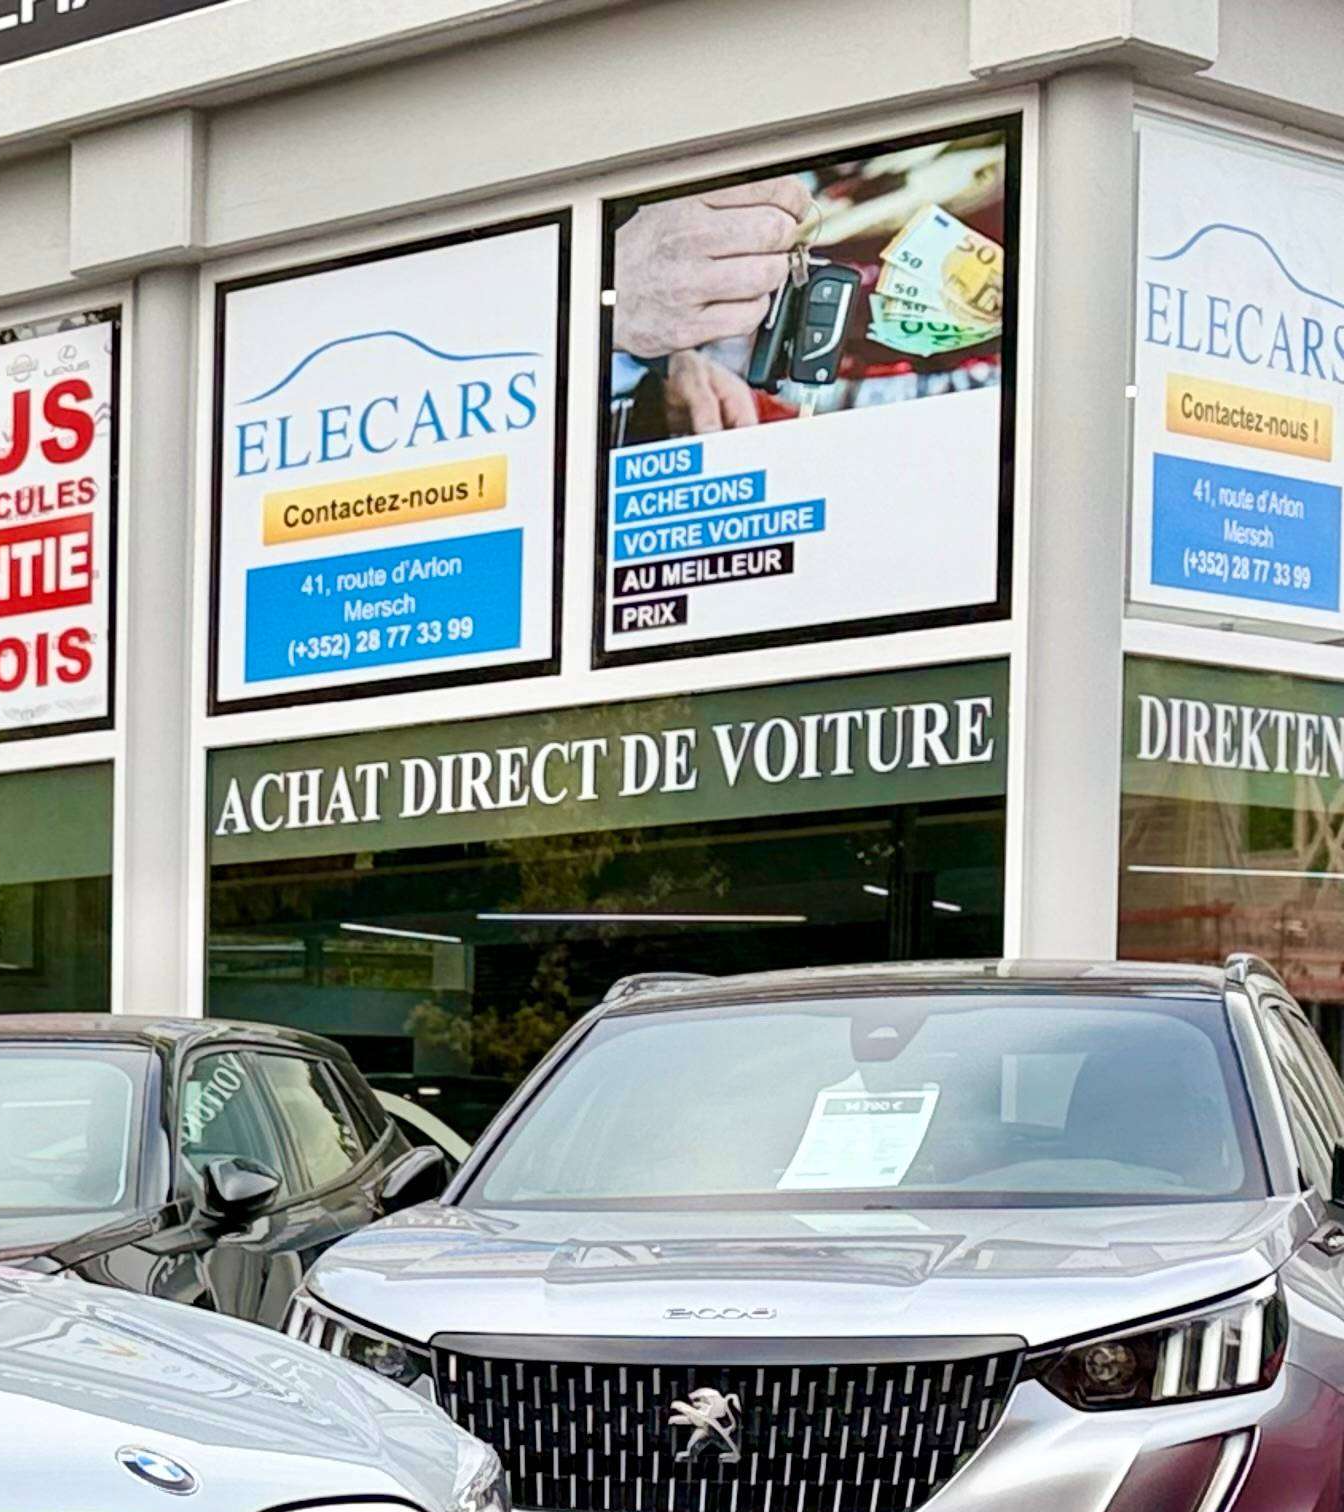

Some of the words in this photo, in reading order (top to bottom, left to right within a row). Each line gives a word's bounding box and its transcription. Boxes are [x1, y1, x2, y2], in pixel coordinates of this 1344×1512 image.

[234, 371, 539, 478] ELECARS
[1181, 392, 1309, 442] Contactez-nous
[625, 448, 692, 481] NOUS
[283, 481, 469, 528] Contactez-nous
[623, 479, 753, 518] ACHETONS
[1219, 486, 1253, 512] route
[623, 523, 703, 556] VOTRE
[709, 505, 814, 545] VOITURE
[1224, 517, 1275, 549] Mersch
[336, 567, 387, 593] route
[622, 566, 656, 593] AU
[662, 550, 782, 585] MEILLEUR
[1183, 547, 1229, 583] (+352)
[1232, 557, 1249, 580] 28
[1252, 559, 1270, 583] 77
[1273, 562, 1291, 587] 33
[1293, 565, 1311, 590] 99
[343, 594, 416, 623] Mersch
[622, 603, 676, 630] PRIX
[288, 634, 351, 667] (+352)
[355, 630, 381, 655] 28
[386, 624, 412, 650] 77
[416, 620, 443, 645] 33
[447, 616, 474, 641] 99
[215, 764, 390, 836] ACHAT
[399, 737, 611, 820] DIRECT
[618, 728, 698, 796] DE
[713, 696, 995, 788] VOITURE
